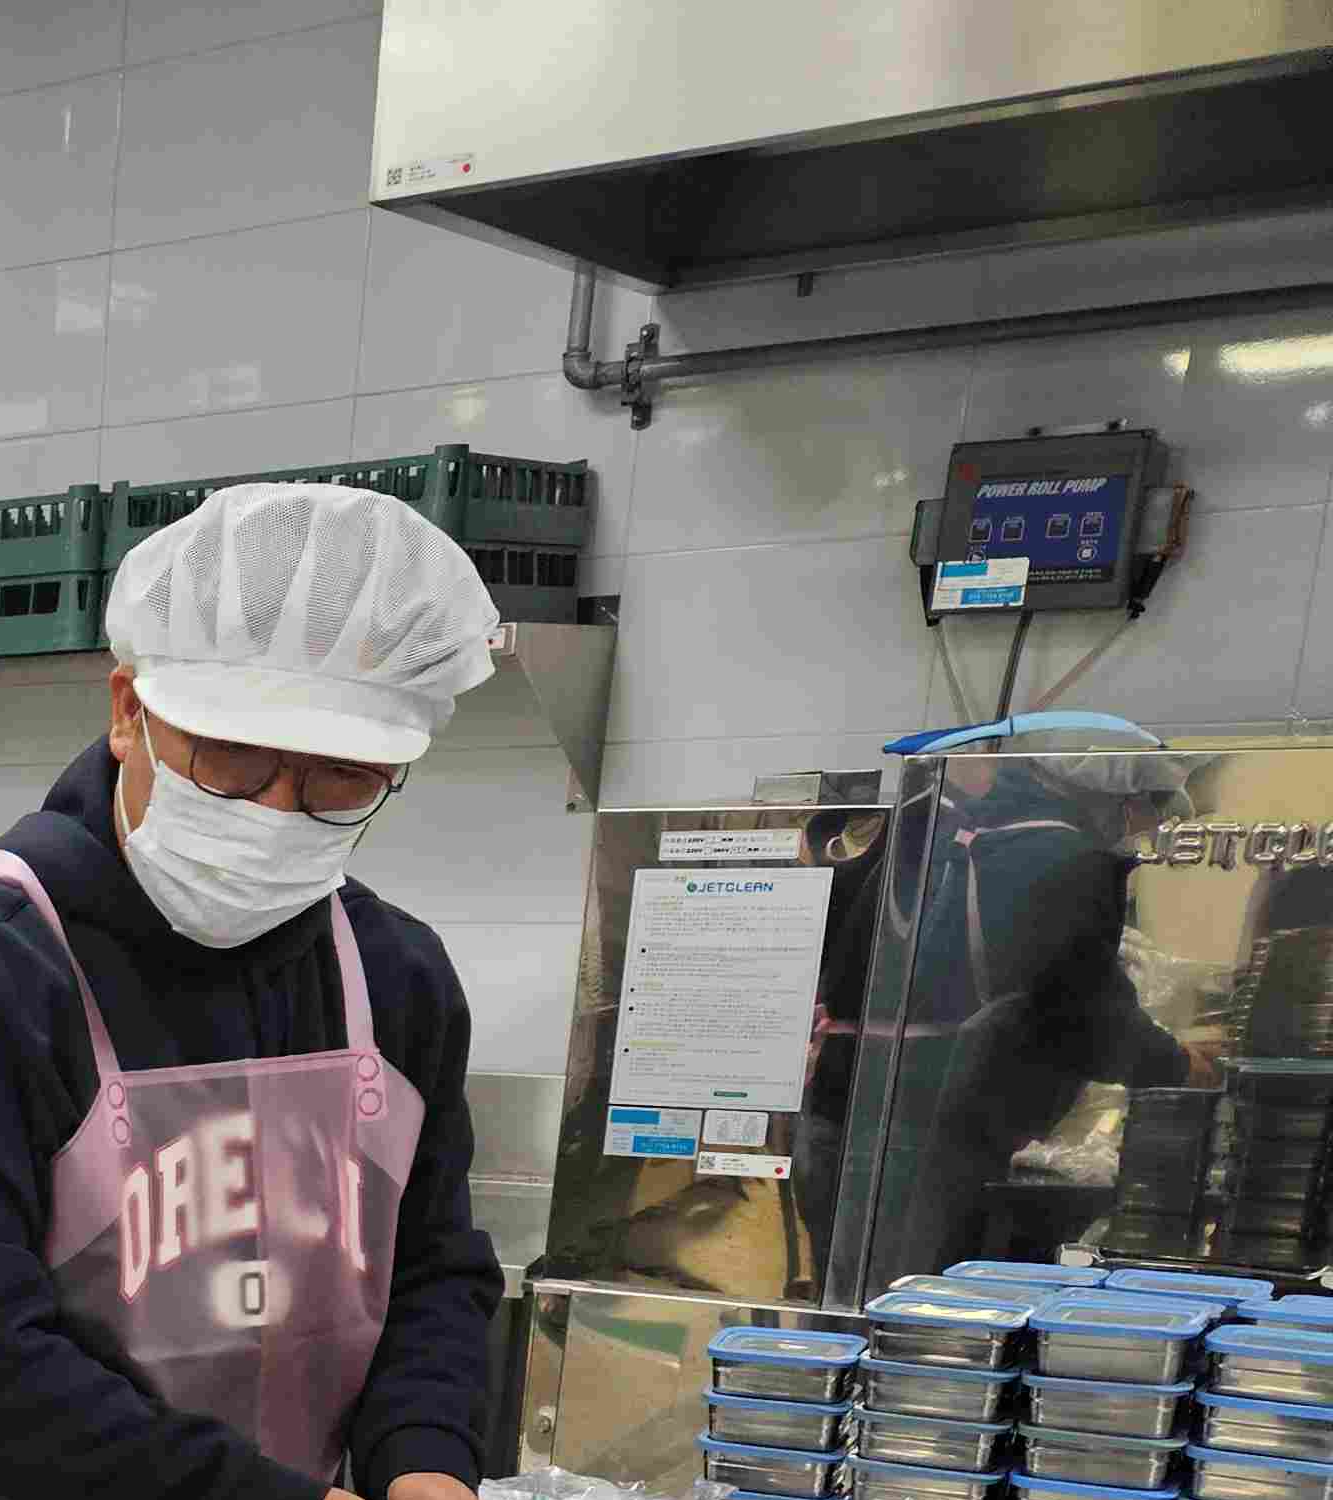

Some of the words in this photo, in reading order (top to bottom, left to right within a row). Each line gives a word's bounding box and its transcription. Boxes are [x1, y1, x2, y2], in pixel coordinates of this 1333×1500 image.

[977, 482, 1027, 498] POWER
[1027, 479, 1062, 496] ROLL
[1062, 477, 1108, 495] PUMP
[697, 881, 774, 894] JETCLEAN
